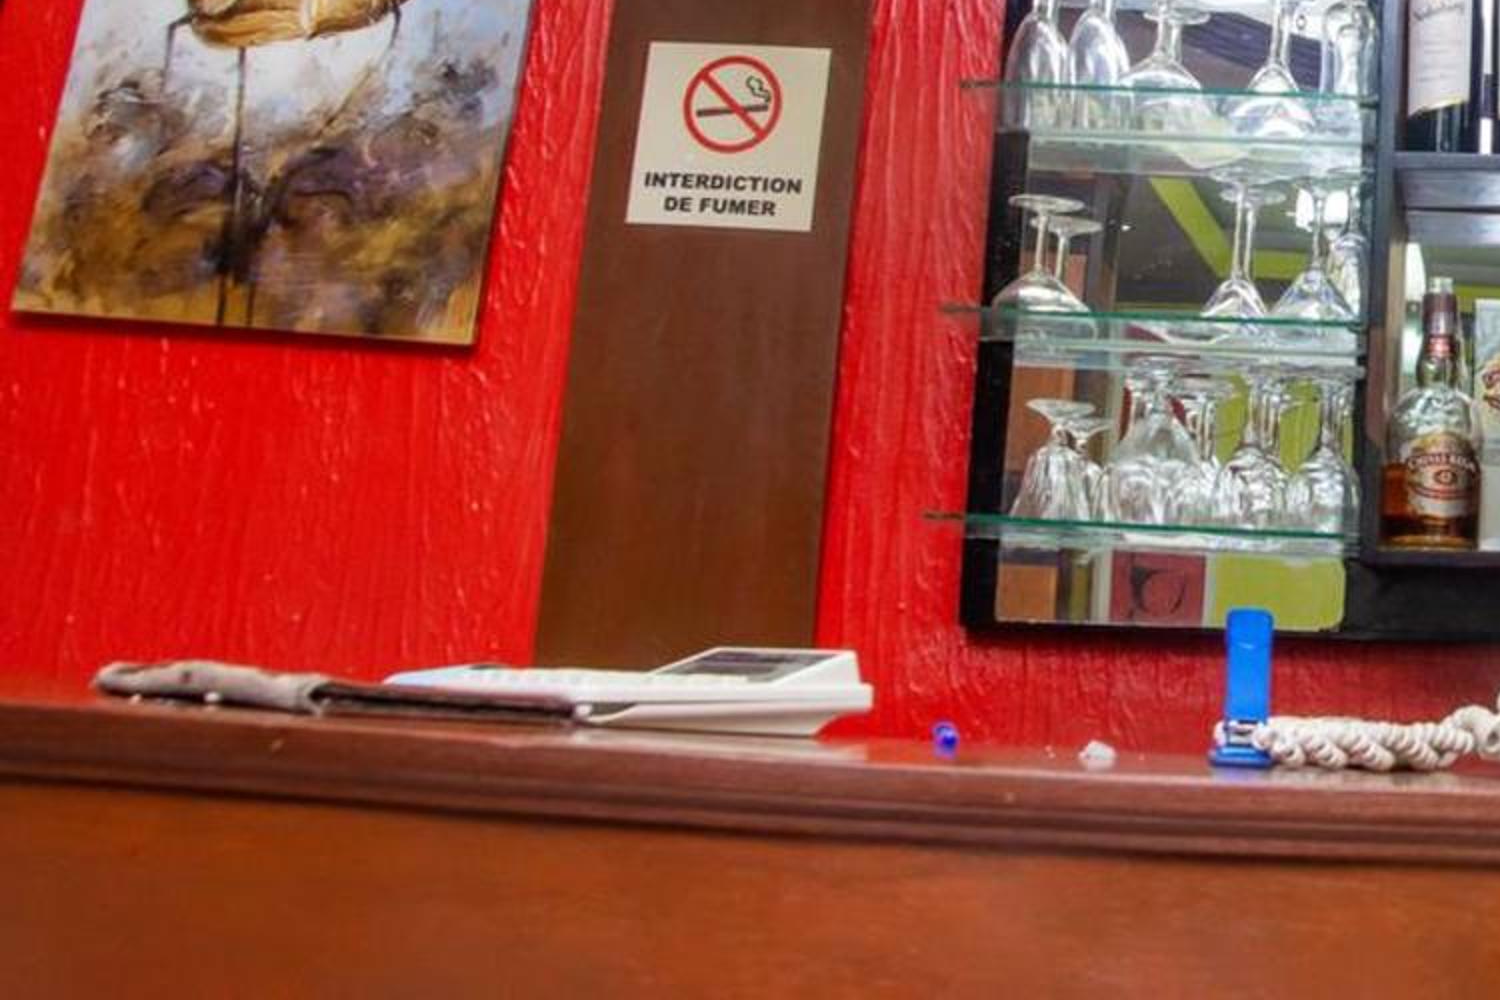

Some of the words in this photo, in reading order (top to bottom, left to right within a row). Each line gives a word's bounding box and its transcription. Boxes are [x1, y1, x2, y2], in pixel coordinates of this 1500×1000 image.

[644, 171, 803, 194] INTERDICTION
[663, 196, 693, 213] DE
[699, 197, 776, 216] FUMER
